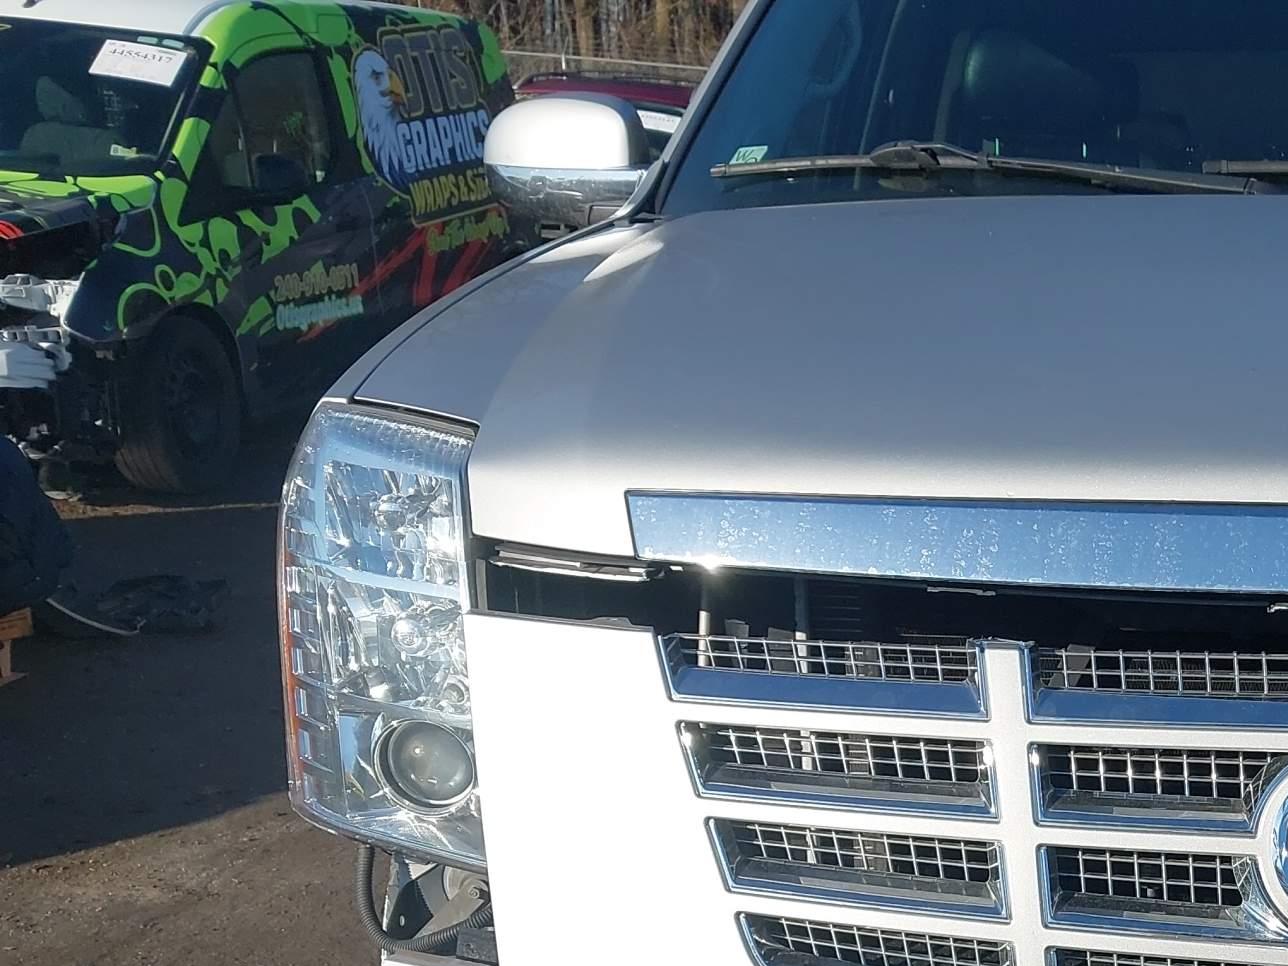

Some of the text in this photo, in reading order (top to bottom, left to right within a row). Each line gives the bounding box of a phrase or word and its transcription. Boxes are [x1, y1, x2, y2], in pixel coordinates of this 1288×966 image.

[382, 28, 477, 117] OTIS
[397, 109, 490, 174] GRAPHICS
[409, 173, 459, 216] WRAPS
[457, 175, 469, 202] &
